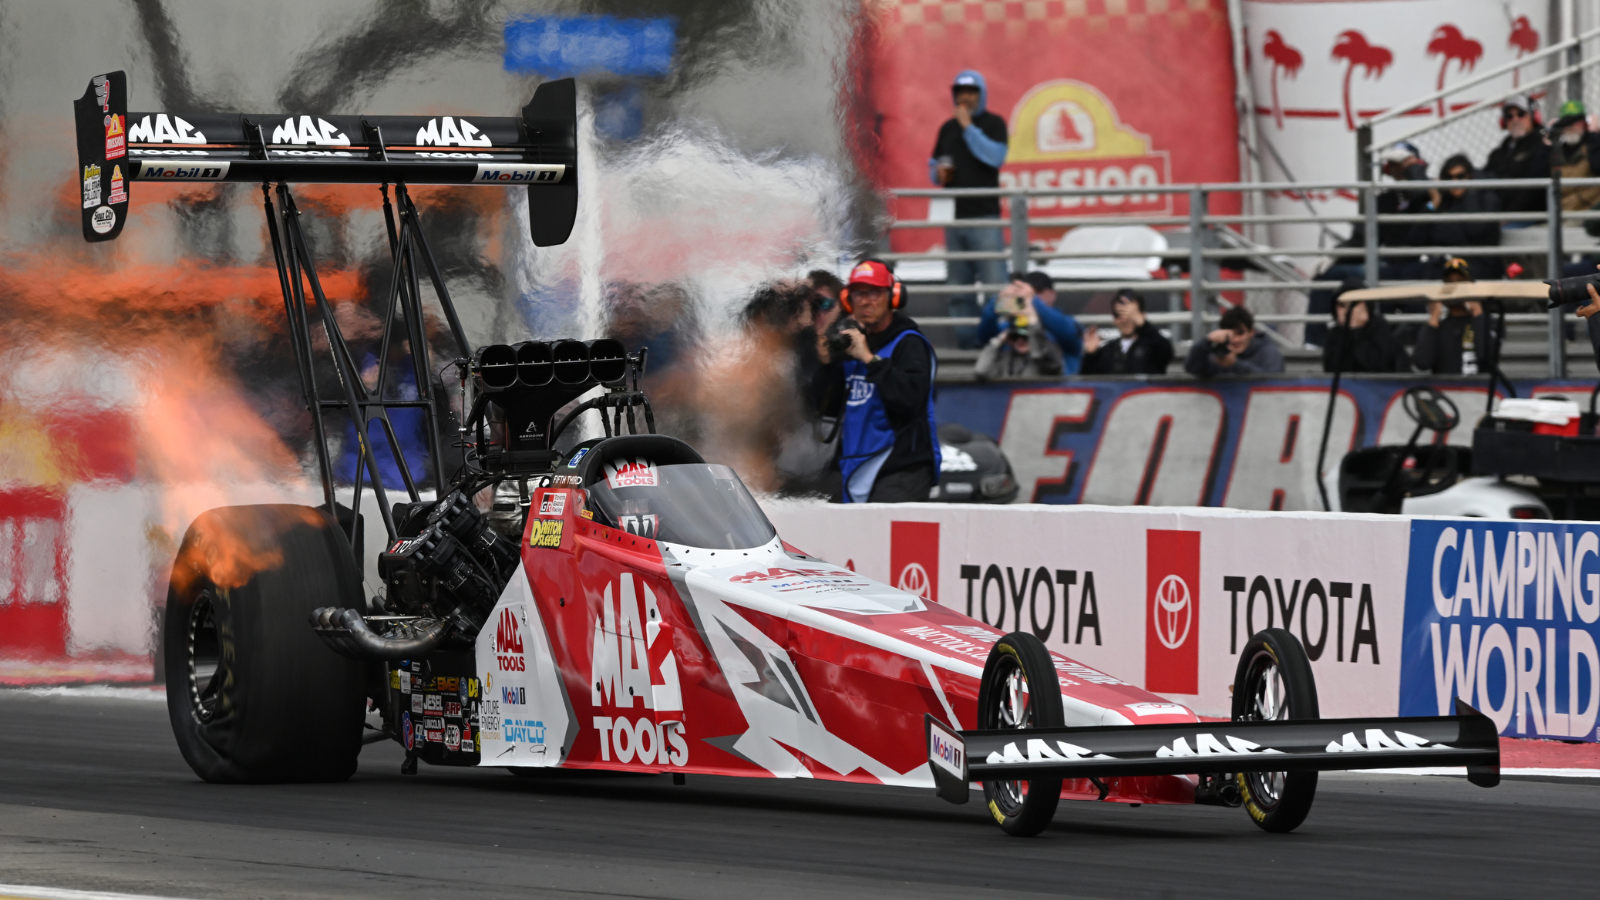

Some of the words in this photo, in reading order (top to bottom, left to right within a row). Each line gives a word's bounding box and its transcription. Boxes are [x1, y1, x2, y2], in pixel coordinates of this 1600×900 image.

[128, 113, 207, 144] MAC
[272, 115, 351, 146] MAC
[416, 116, 492, 147] MAC
[107, 135, 124, 149] MISSION
[145, 167, 200, 178] Mobil
[480, 170, 536, 181] Mobil
[553, 475, 567, 484] FIFTH
[567, 475, 583, 485] THIRD
[615, 462, 653, 479] MAC
[616, 477, 654, 487] TOOLS
[1432, 526, 1600, 624] CAMPING
[960, 563, 1103, 646] TOYOTA
[496, 607, 524, 654] MAC
[1223, 575, 1380, 665] TOYOTA
[591, 572, 684, 712] MAC
[497, 655, 526, 672] TOOLS
[1430, 623, 1600, 738] WORLD
[424, 694, 443, 710] JESEL
[445, 702, 461, 714] ARP
[481, 700, 500, 715] FUTURE
[501, 686, 519, 705] Mobil
[424, 718, 441, 730] LINCOLN
[481, 715, 501, 730] ENERGY
[502, 718, 547, 744] DAYCO
[593, 715, 689, 767] TOOLS
[933, 733, 954, 765] Mobil
[986, 739, 1126, 764] MAC
[1155, 733, 1292, 759] MAC
[1325, 728, 1457, 753] MAC
